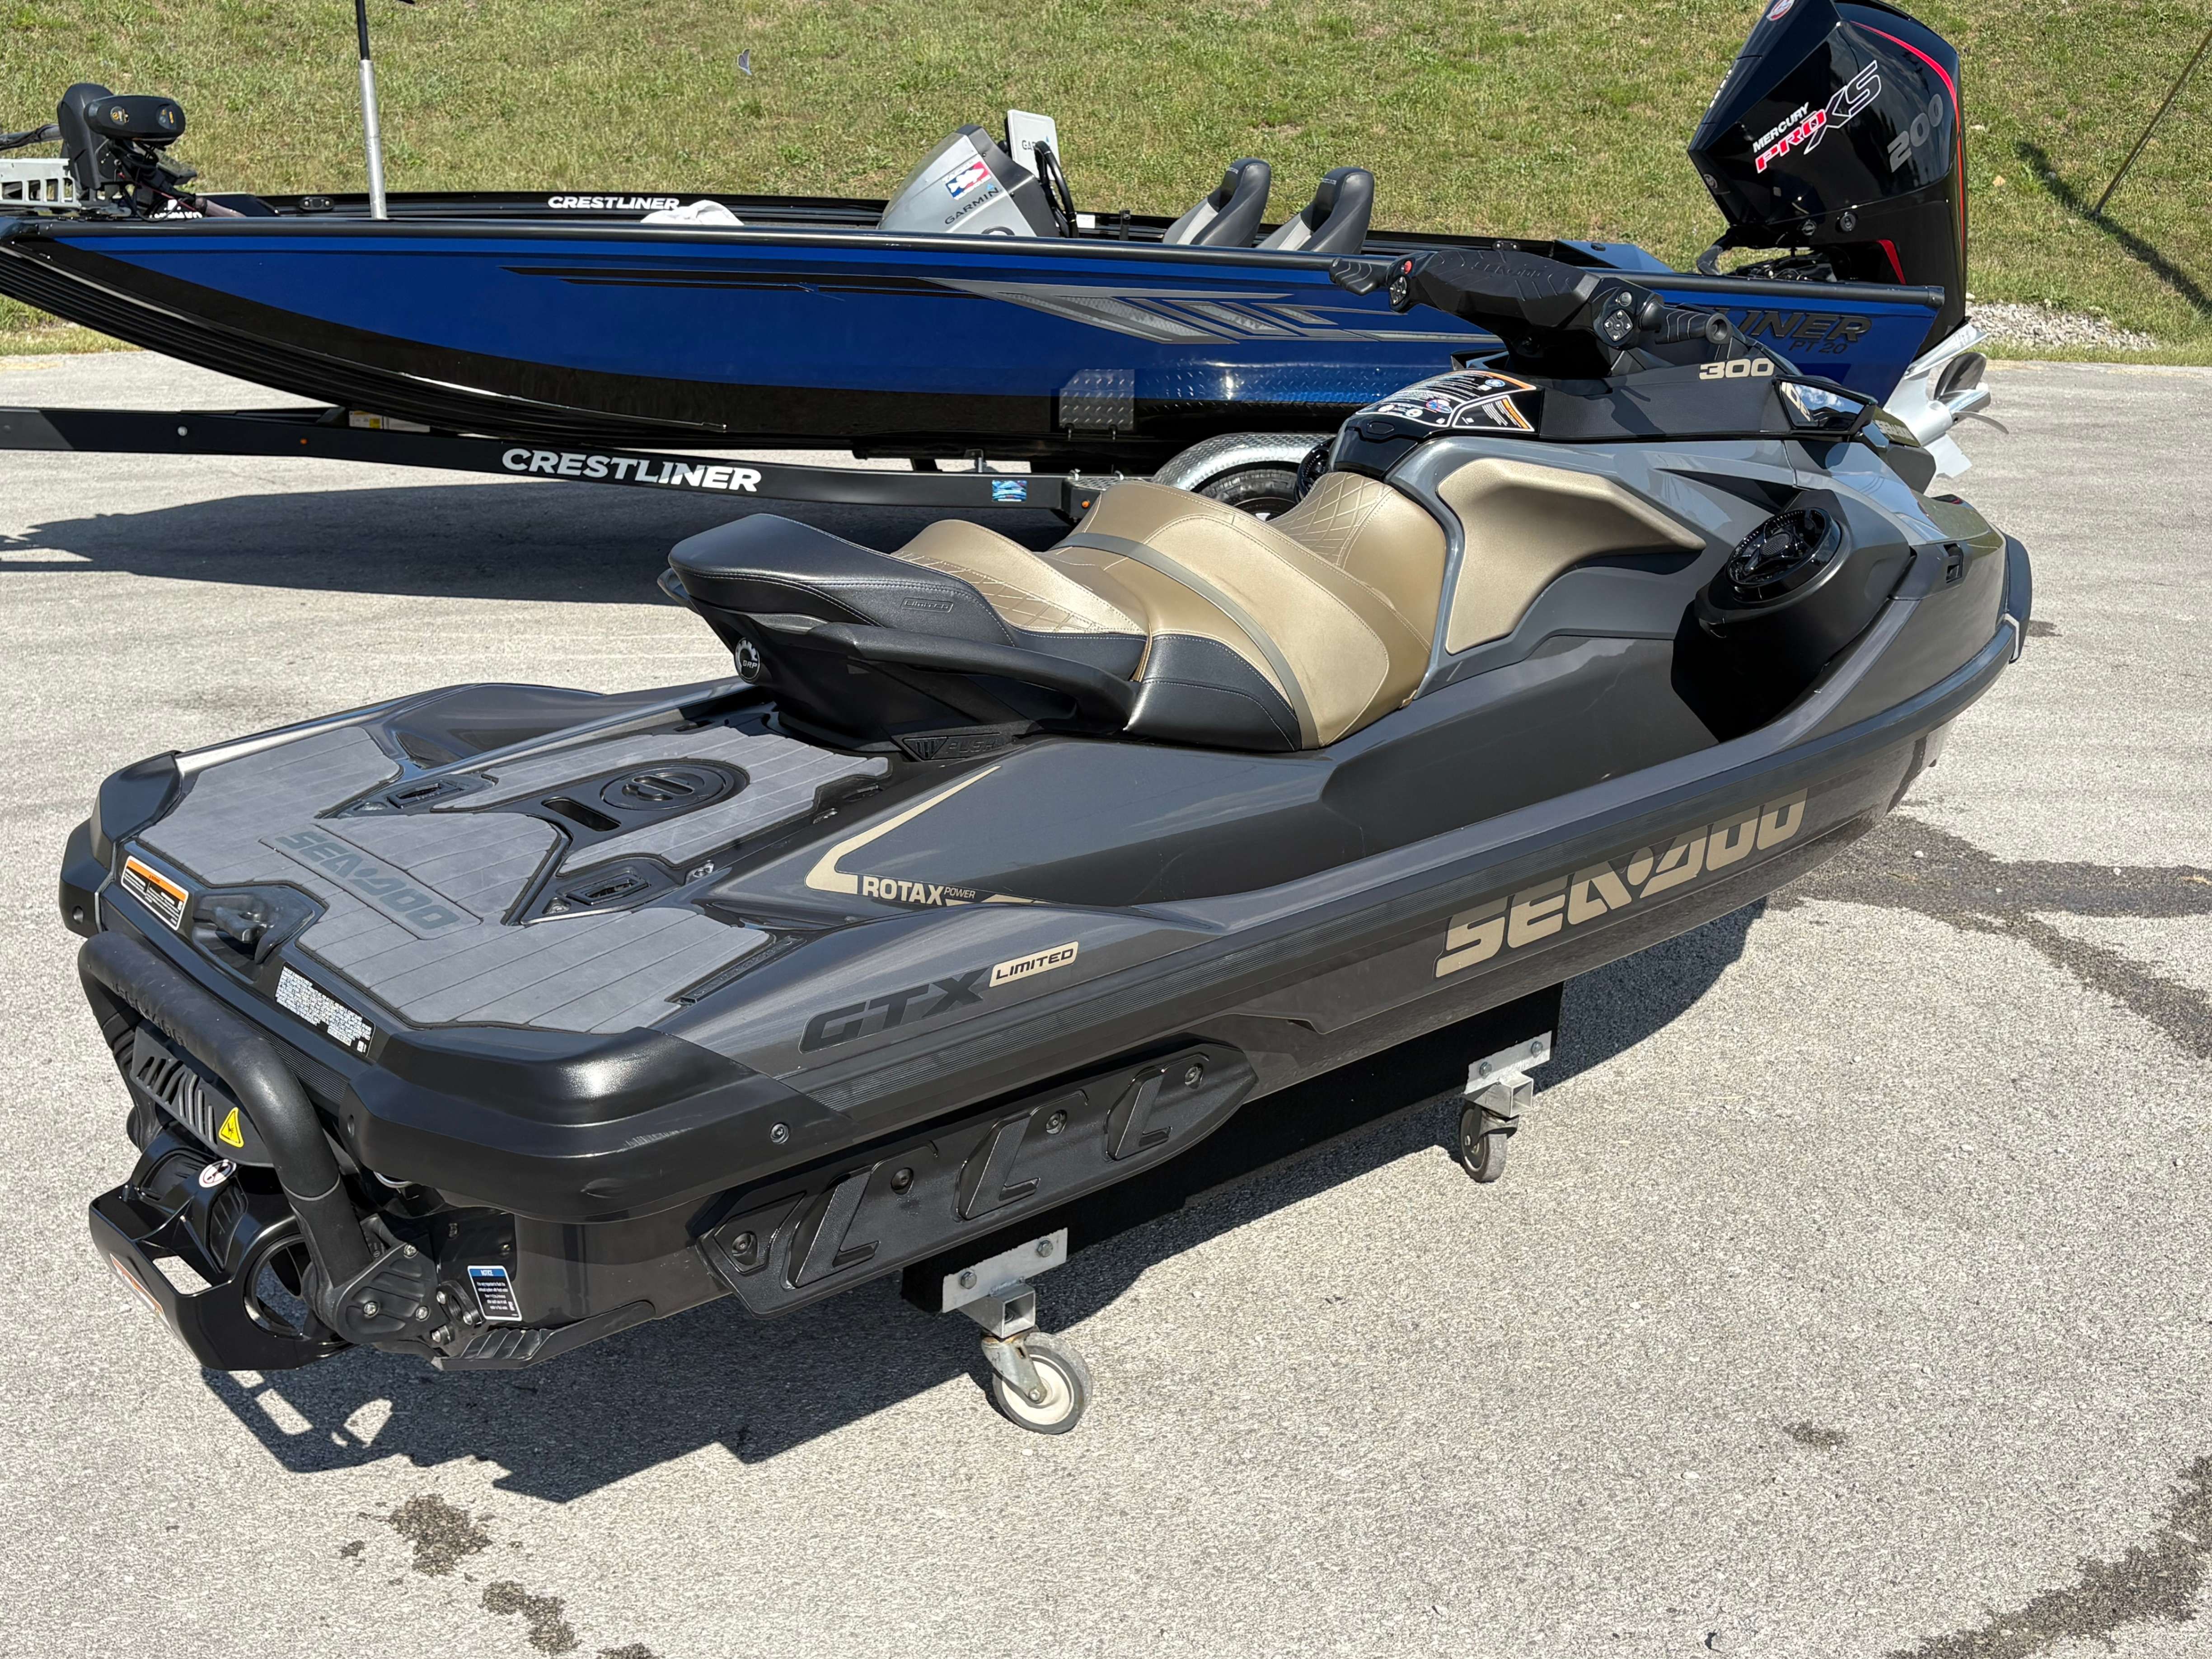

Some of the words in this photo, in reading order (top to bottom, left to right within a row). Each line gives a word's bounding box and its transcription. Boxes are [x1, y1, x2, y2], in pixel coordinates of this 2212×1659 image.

[1753, 102, 1809, 153] MERCURY
[1887, 94, 1943, 173] 200
[548, 196, 680, 210] CRESTLINER
[945, 187, 999, 225] GARMIN
[1715, 307, 1872, 342] INER
[1788, 339, 1819, 352] PT
[1818, 342, 1848, 354] 20
[1699, 358, 1775, 380] 300
[502, 448, 762, 493] CRESTLINER
[904, 600, 949, 609] LIMITED
[742, 659, 758, 669] BRP
[862, 875, 946, 906] ROTAX
[943, 886, 976, 899] POWER
[996, 948, 1075, 980] LIMITED
[798, 966, 993, 1054] GTX
